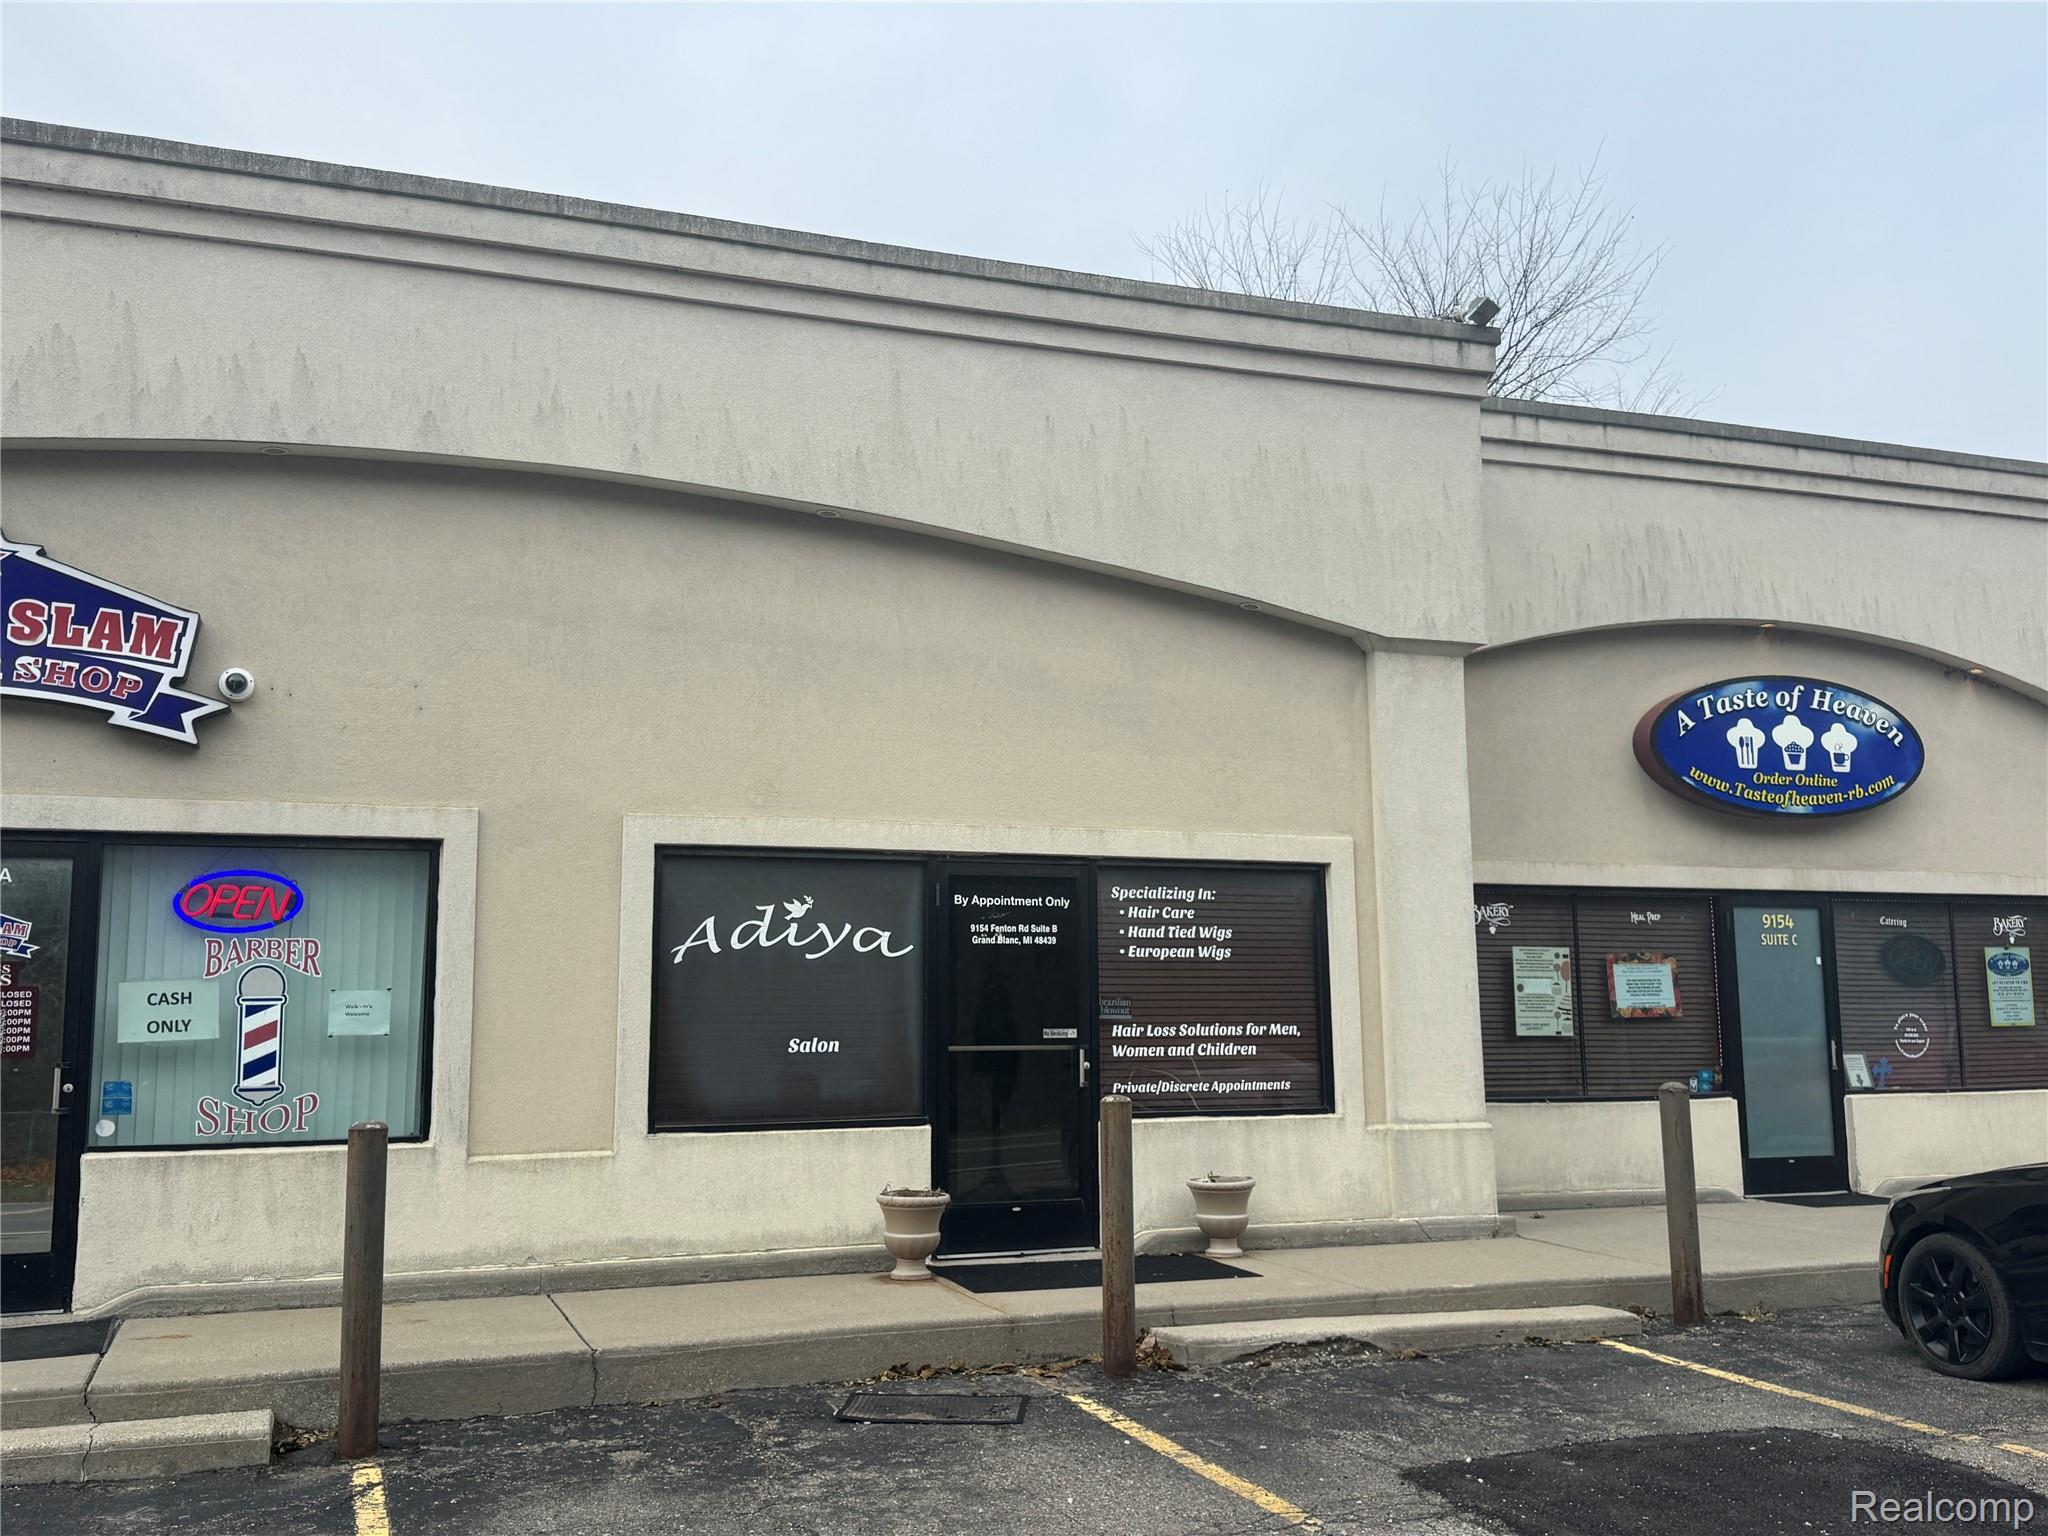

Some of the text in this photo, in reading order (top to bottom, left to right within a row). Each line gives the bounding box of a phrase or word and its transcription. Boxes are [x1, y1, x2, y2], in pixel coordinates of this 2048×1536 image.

[7, 599, 184, 664] SLAM
[13, 656, 143, 699] SHOP
[1675, 685, 1904, 747] A Taste of Heaven
[1688, 764, 1895, 808] www.Tasteofheaven-rb.com
[1753, 771, 1838, 787] Order Online
[954, 894, 1070, 909] By Appointment Only
[1111, 886, 1217, 902] Specializing In:
[181, 883, 293, 921] OPEN
[1128, 906, 1195, 919] Hair Care
[970, 924, 1058, 933] 9154 Fenton Rd Suite B
[1762, 914, 1794, 929] 9154
[1880, 916, 1907, 928] Catering
[670, 904, 914, 964] Adiya
[972, 935, 1057, 945] Grand Blanc, MI 48439
[1128, 926, 1233, 941] Hand Tied Wigs
[1761, 933, 1798, 946] SUITE C
[203, 938, 321, 978] BARBER
[1128, 945, 1232, 960] European Wigs
[147, 991, 192, 1006] CASH
[147, 1019, 192, 1034] ONLY
[1112, 1023, 1301, 1037] Hair Loss Solutions for Men,
[788, 1037, 840, 1053] Salon
[1112, 1042, 1257, 1057] Women and Children
[1113, 1080, 1291, 1095] Private/Discrete Appointments
[195, 1093, 319, 1136] SHOP
